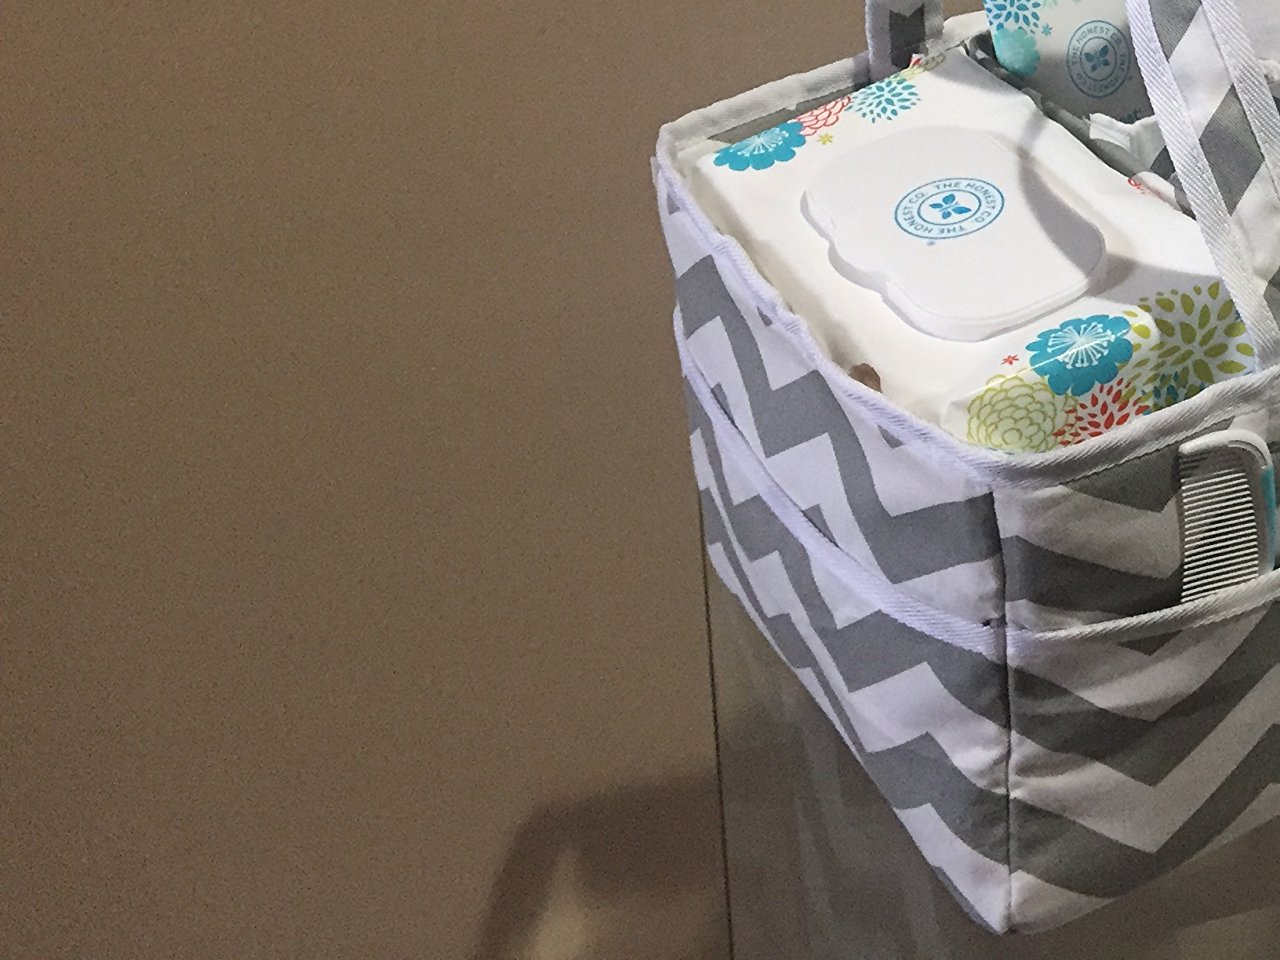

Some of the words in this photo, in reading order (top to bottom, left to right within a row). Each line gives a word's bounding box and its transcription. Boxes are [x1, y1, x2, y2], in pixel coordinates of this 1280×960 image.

[1076, 25, 1110, 44] HONEST
[935, 181, 962, 191] THE
[964, 182, 996, 210] HONEST
[902, 206, 933, 235] HONEST
[938, 224, 967, 236] THE
